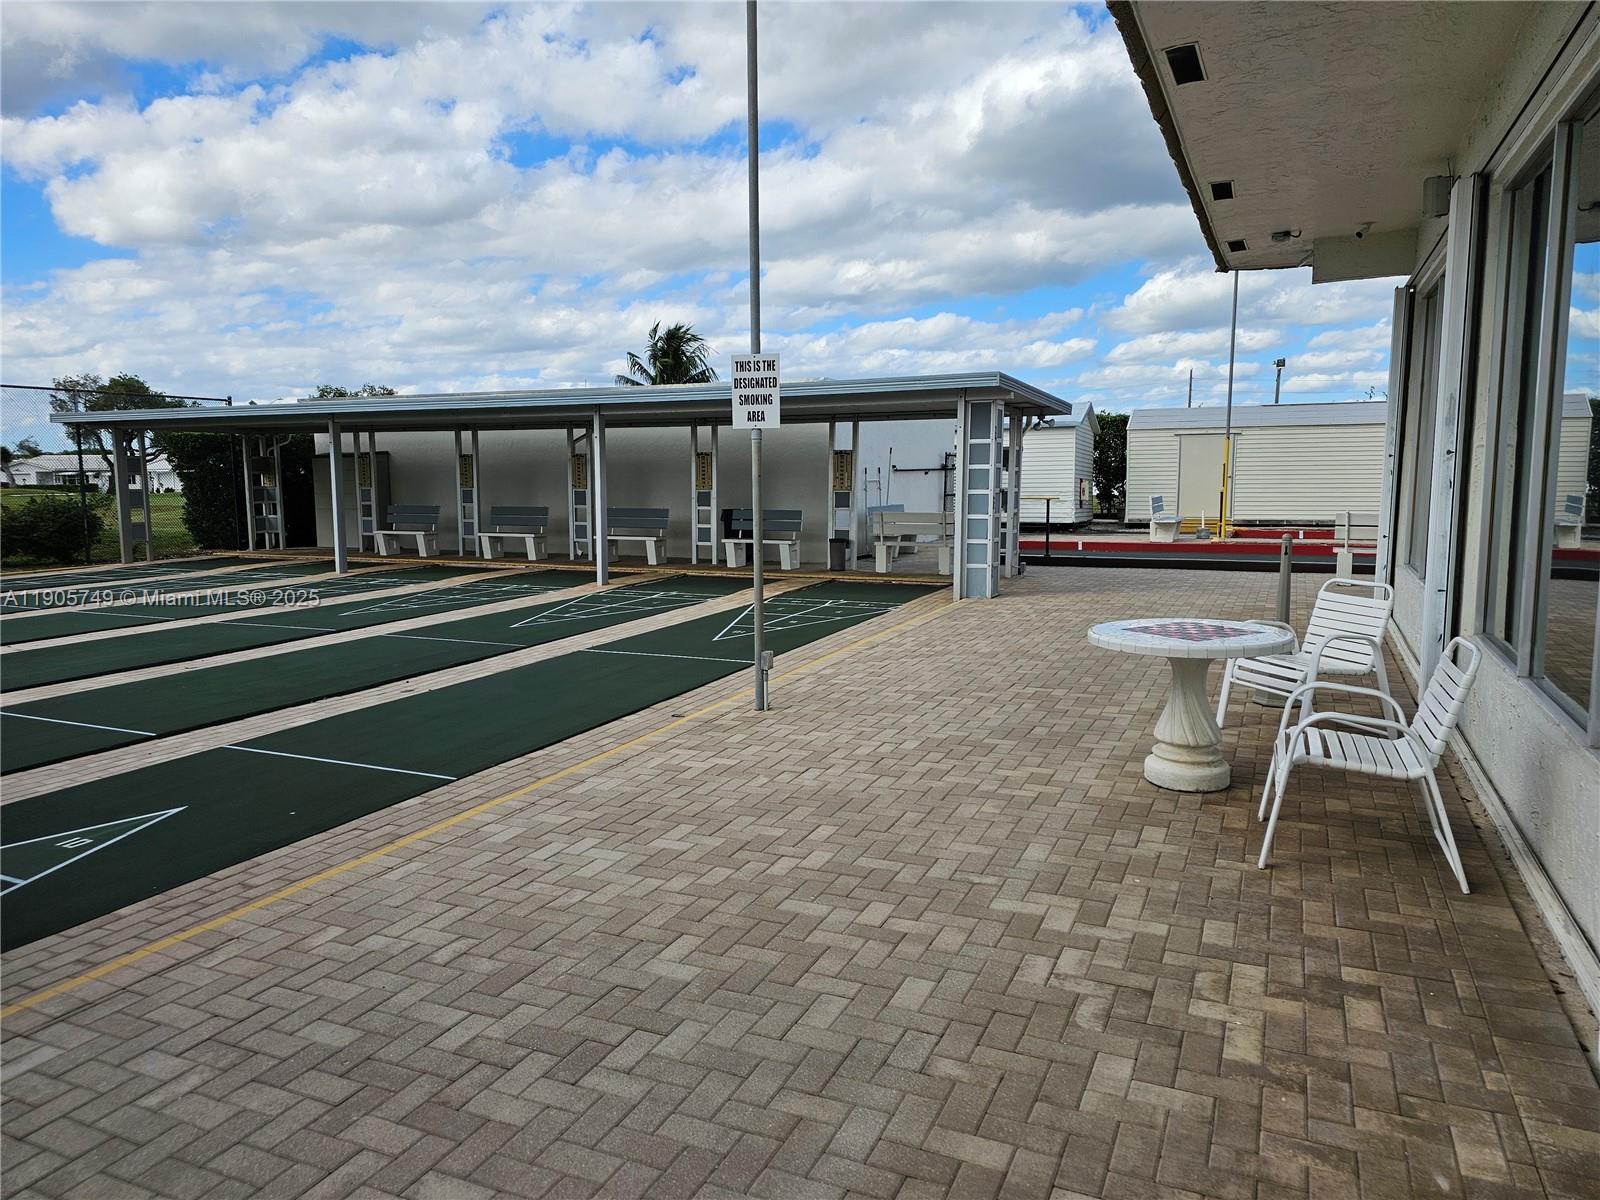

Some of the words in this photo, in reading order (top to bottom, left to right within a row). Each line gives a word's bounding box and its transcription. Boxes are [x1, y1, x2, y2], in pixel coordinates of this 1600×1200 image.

[735, 361, 751, 372] THIS
[754, 360, 760, 372] IS
[762, 360, 776, 371] THE
[734, 377, 777, 389] DESIGNATED
[739, 394, 772, 406] SMOKING
[747, 411, 765, 422] AREA
